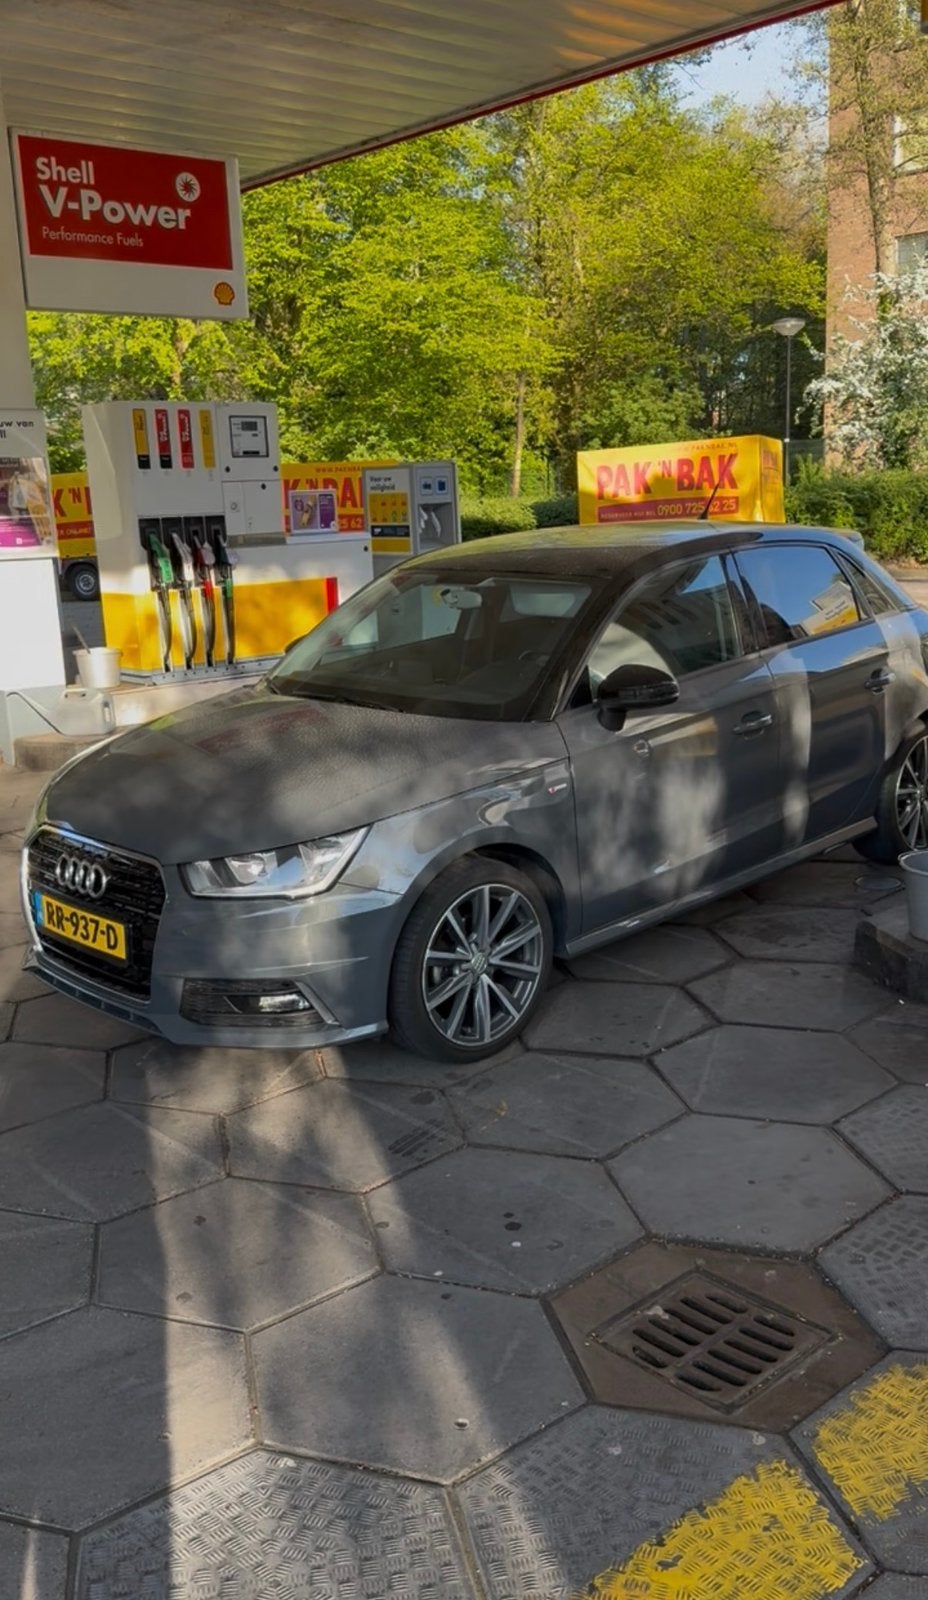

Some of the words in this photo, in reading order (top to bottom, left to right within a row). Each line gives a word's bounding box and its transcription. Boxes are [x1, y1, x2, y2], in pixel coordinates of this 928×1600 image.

[35, 156, 95, 185] Shell
[39, 184, 192, 230] V-Power
[42, 226, 114, 245] Performance
[117, 232, 144, 247] Fuels
[16, 420, 34, 428] van
[596, 461, 652, 500] PAK
[677, 453, 738, 492] BAK
[657, 503, 683, 515] 0900
[685, 502, 705, 514] 725
[722, 499, 736, 511] 25
[45, 900, 119, 951] RR-937-D
